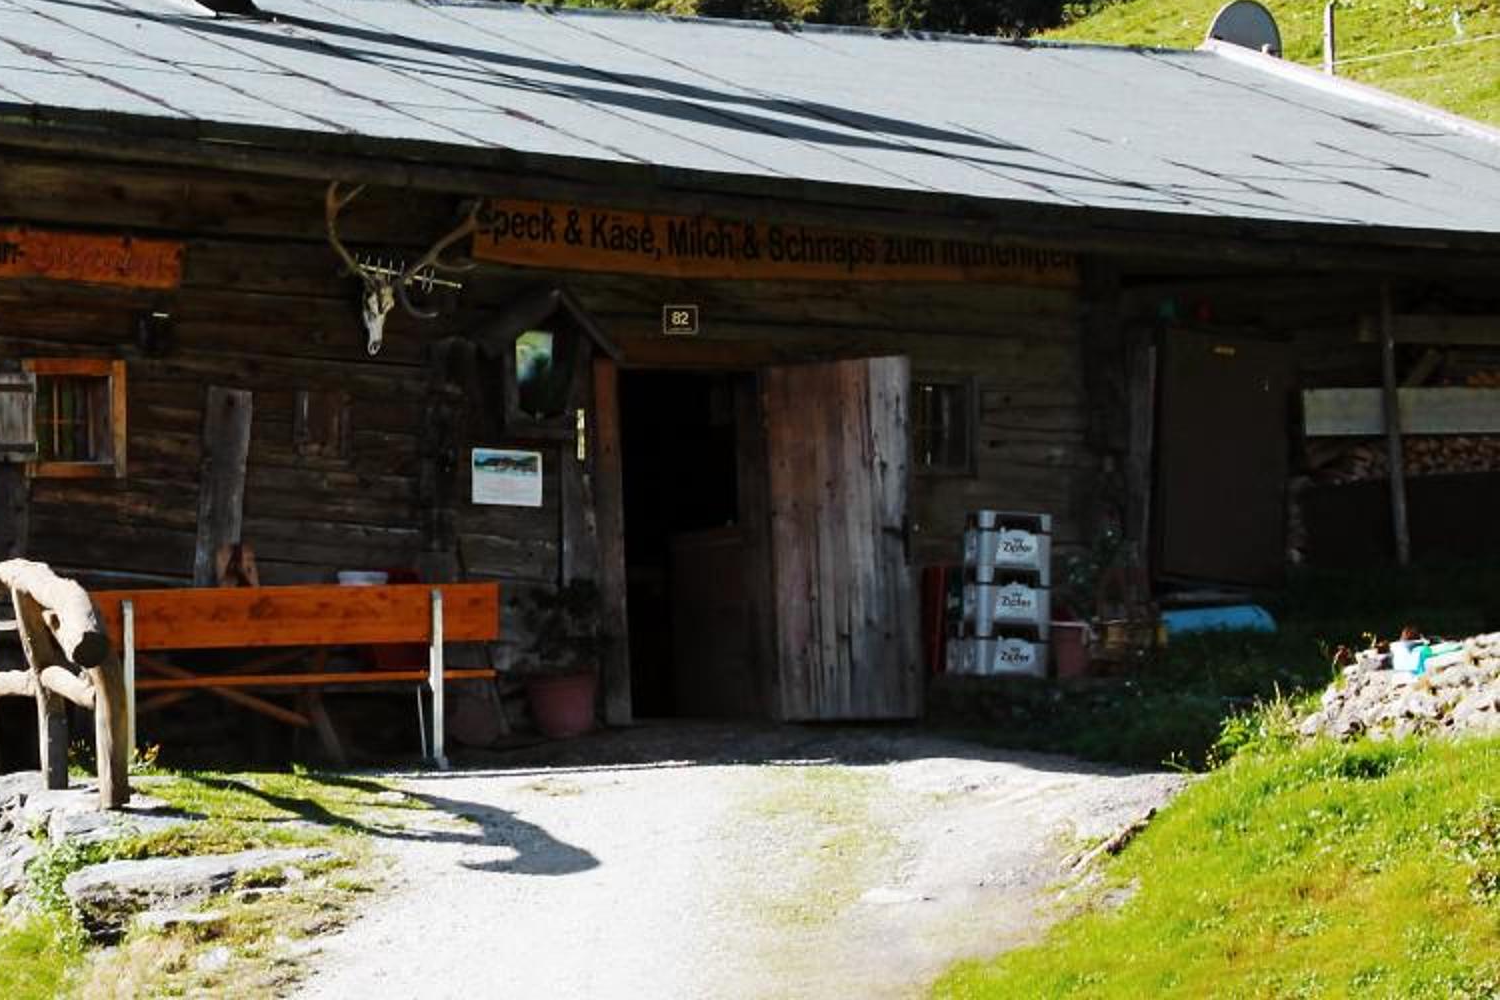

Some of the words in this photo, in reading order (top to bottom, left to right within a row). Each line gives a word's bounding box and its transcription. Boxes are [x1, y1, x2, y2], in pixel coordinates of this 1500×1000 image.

[563, 209, 582, 246] &
[590, 213, 661, 262] Käse,
[667, 213, 733, 258] Milch
[740, 216, 760, 260] &
[769, 226, 877, 274] Schnaps
[671, 311, 689, 325] 82
